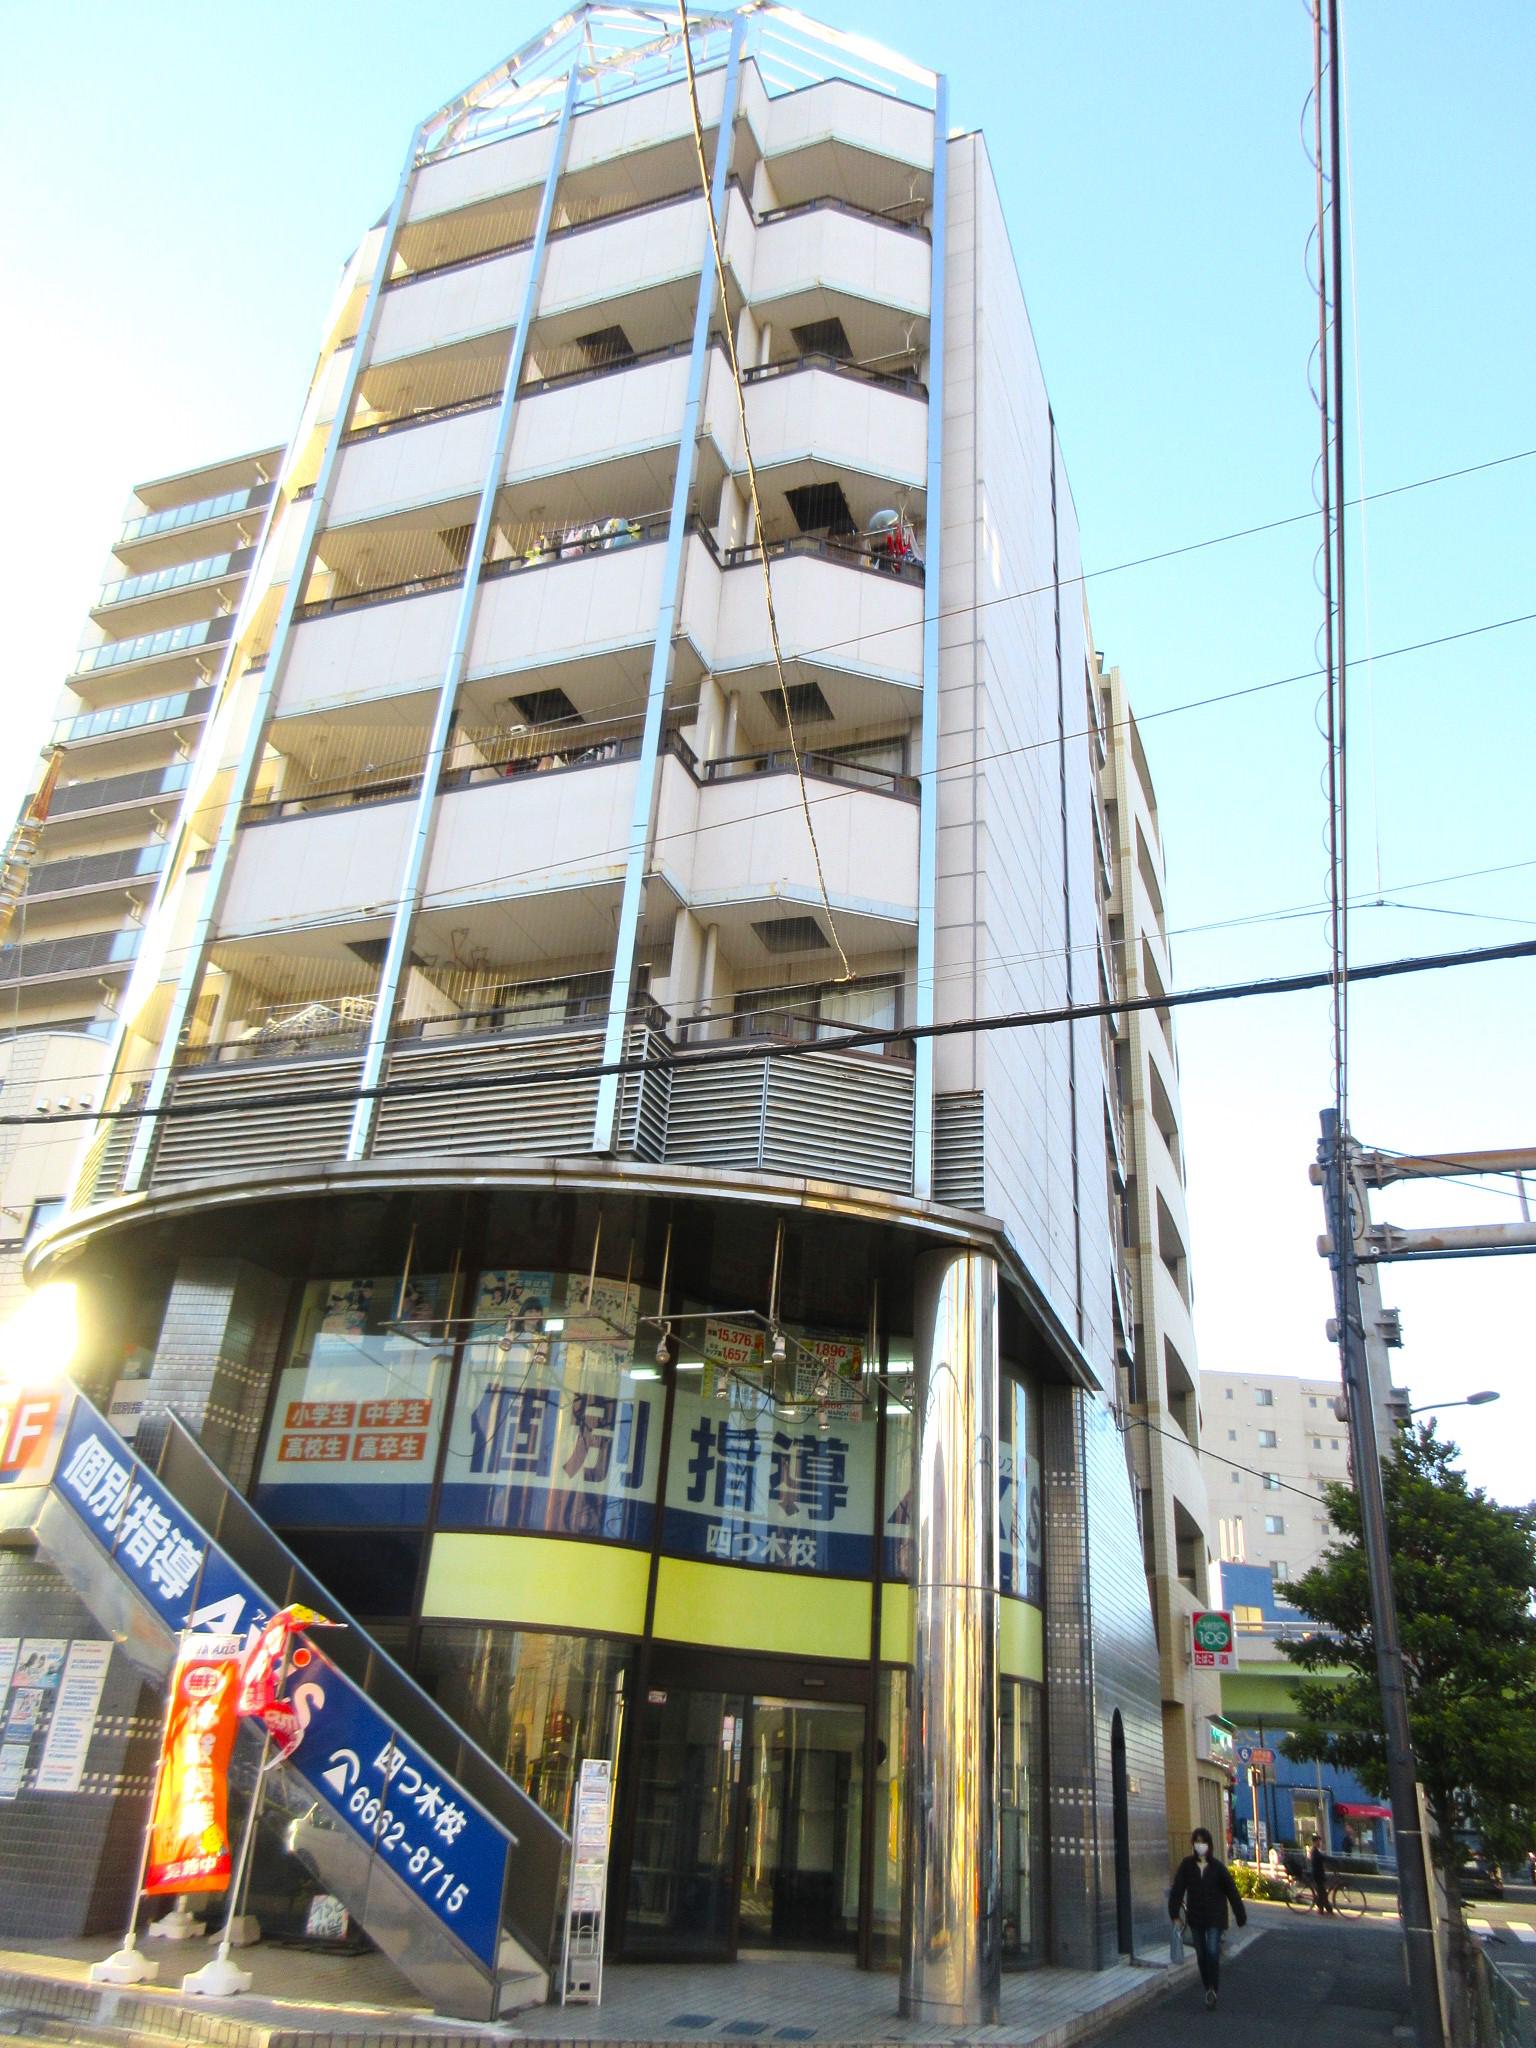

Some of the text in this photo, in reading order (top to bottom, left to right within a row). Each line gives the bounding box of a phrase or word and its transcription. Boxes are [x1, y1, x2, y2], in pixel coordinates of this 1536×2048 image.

[291, 1401, 425, 1427] 小学生 中学生
[284, 1435, 420, 1459] 高校生 高卒生
[63, 1433, 204, 1600] 個別指導
[706, 1523, 818, 1569] 四つ木校
[1200, 1630, 1228, 1645] 100
[1241, 1748, 1249, 1761] 6
[372, 1740, 468, 1845] 四つ木校
[349, 1785, 470, 1912] 6662-8715
